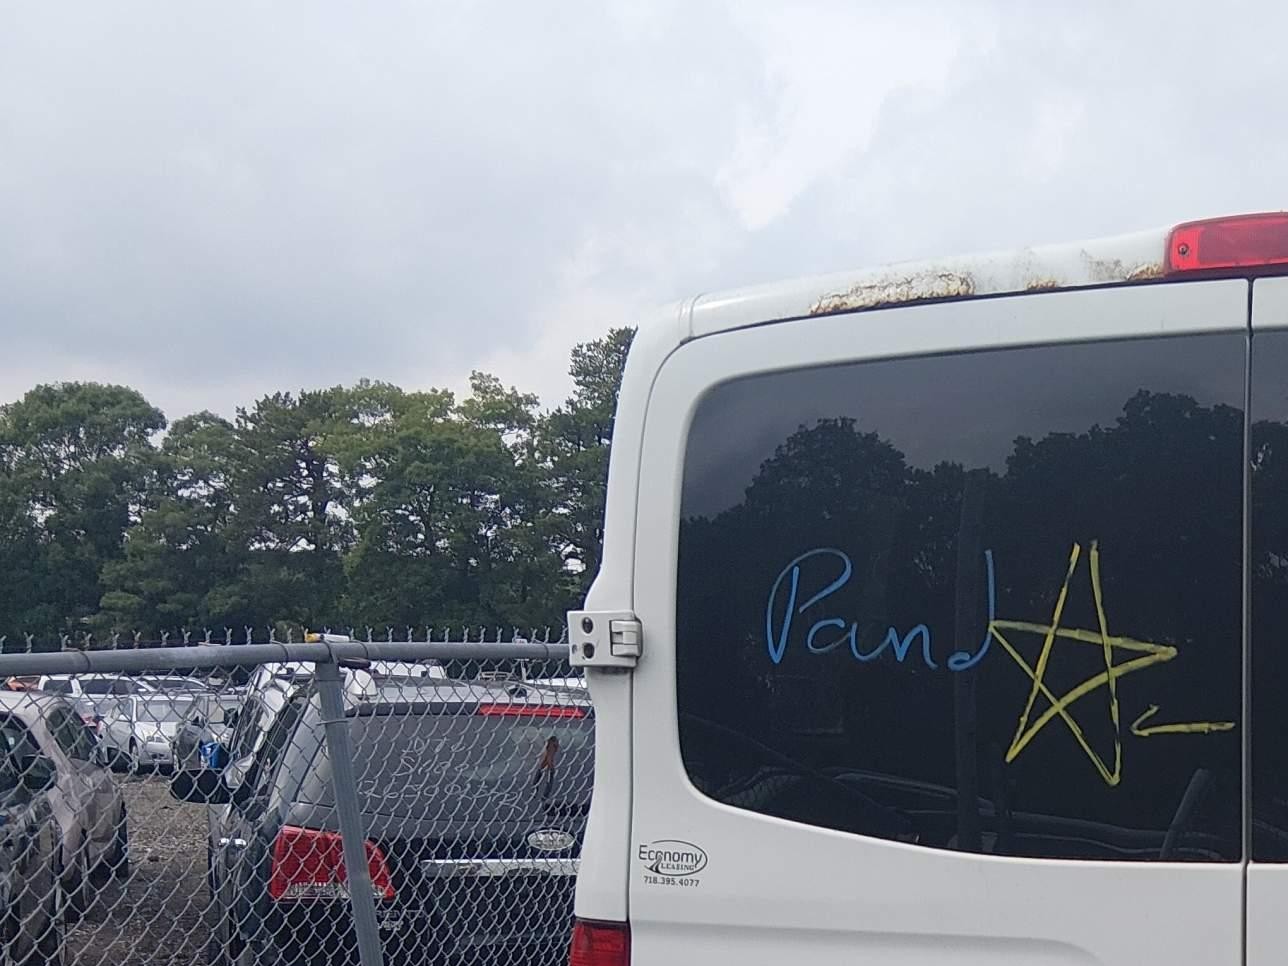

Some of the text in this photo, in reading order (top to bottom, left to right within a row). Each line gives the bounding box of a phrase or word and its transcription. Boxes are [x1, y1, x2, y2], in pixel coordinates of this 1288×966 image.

[639, 844, 702, 869] Economy
[660, 862, 695, 871] LEASING
[644, 875, 700, 887] 718.395.4077
